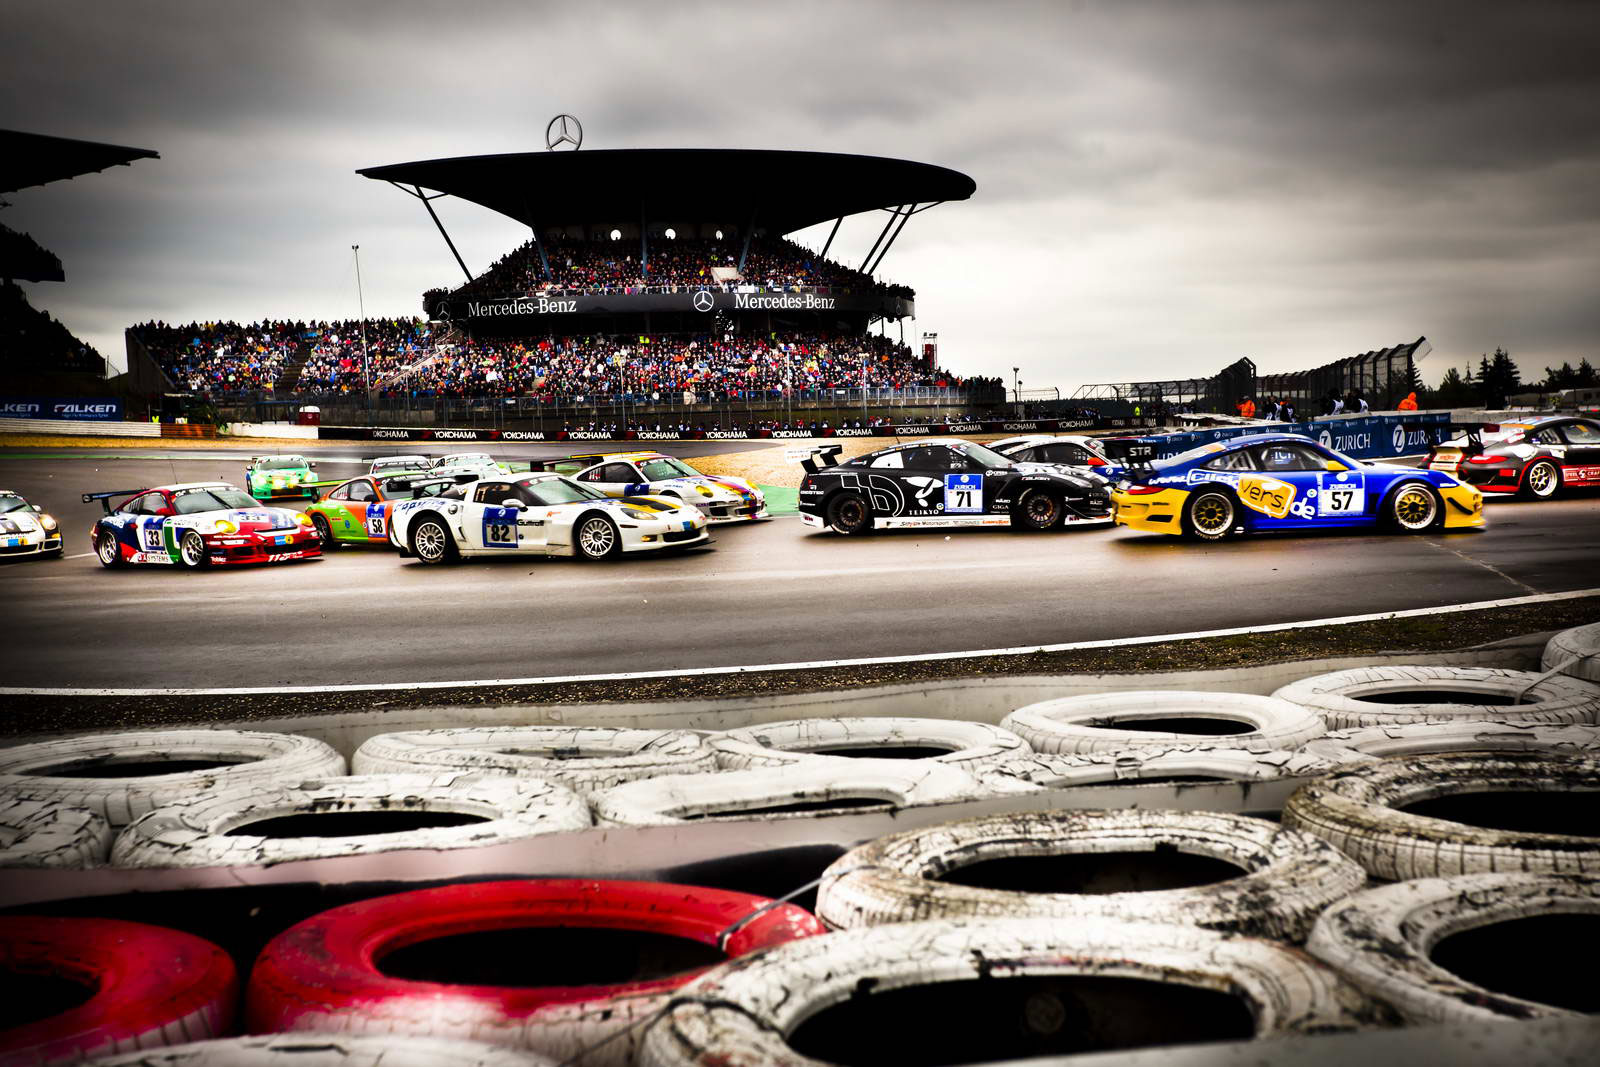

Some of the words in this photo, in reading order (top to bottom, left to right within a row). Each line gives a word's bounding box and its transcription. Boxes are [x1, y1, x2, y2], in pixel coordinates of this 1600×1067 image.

[734, 293, 835, 310] Mercedes-Benz
[468, 299, 577, 318] Mercedes-Benz
[54, 404, 117, 413] FALKEN
[949, 424, 982, 433] YOKOHAMA
[1003, 422, 1037, 431] YOKOHAMA
[1058, 419, 1094, 429] YOKOHAMA
[705, 430, 748, 439] YOKOHAMA
[771, 430, 812, 438] YOKOHAMA
[835, 428, 873, 436] YOKOHAMA
[895, 426, 930, 435] YOKOHAMA
[434, 431, 477, 440] YOKOHAMA
[502, 432, 545, 440] YOKOHAMA
[568, 431, 612, 440] YOKOHAMA
[637, 431, 680, 440] YOKOHAMA
[1335, 433, 1371, 452] ZURICH
[1129, 446, 1152, 457] STR
[956, 491, 972, 508] 71
[1331, 491, 1354, 511] 57
[371, 518, 383, 534] 58
[148, 530, 161, 546] 33
[490, 525, 511, 542] 82
